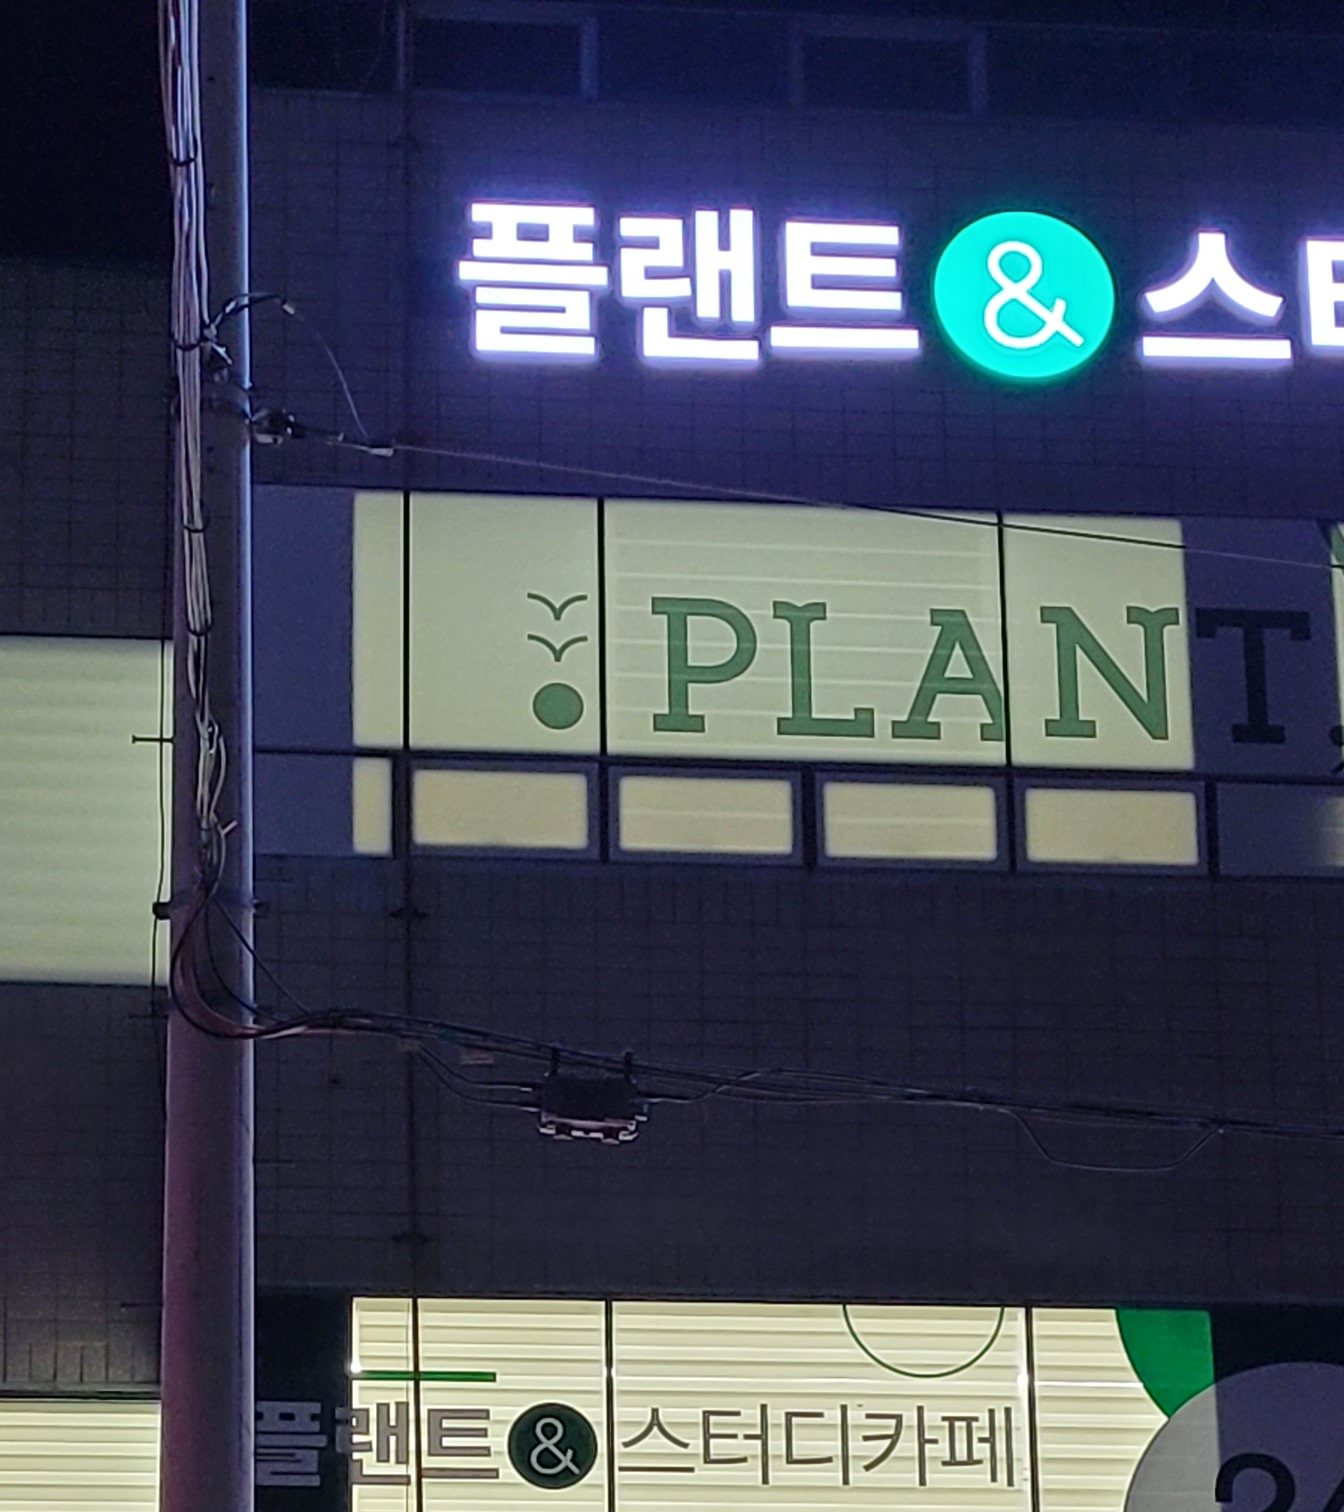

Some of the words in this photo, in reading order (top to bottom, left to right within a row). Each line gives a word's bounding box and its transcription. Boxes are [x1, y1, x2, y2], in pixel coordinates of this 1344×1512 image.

[458, 202, 919, 360] 플랜트
[256, 1401, 500, 1487] 플랜트
[618, 1403, 1017, 1488] 스터디카페
